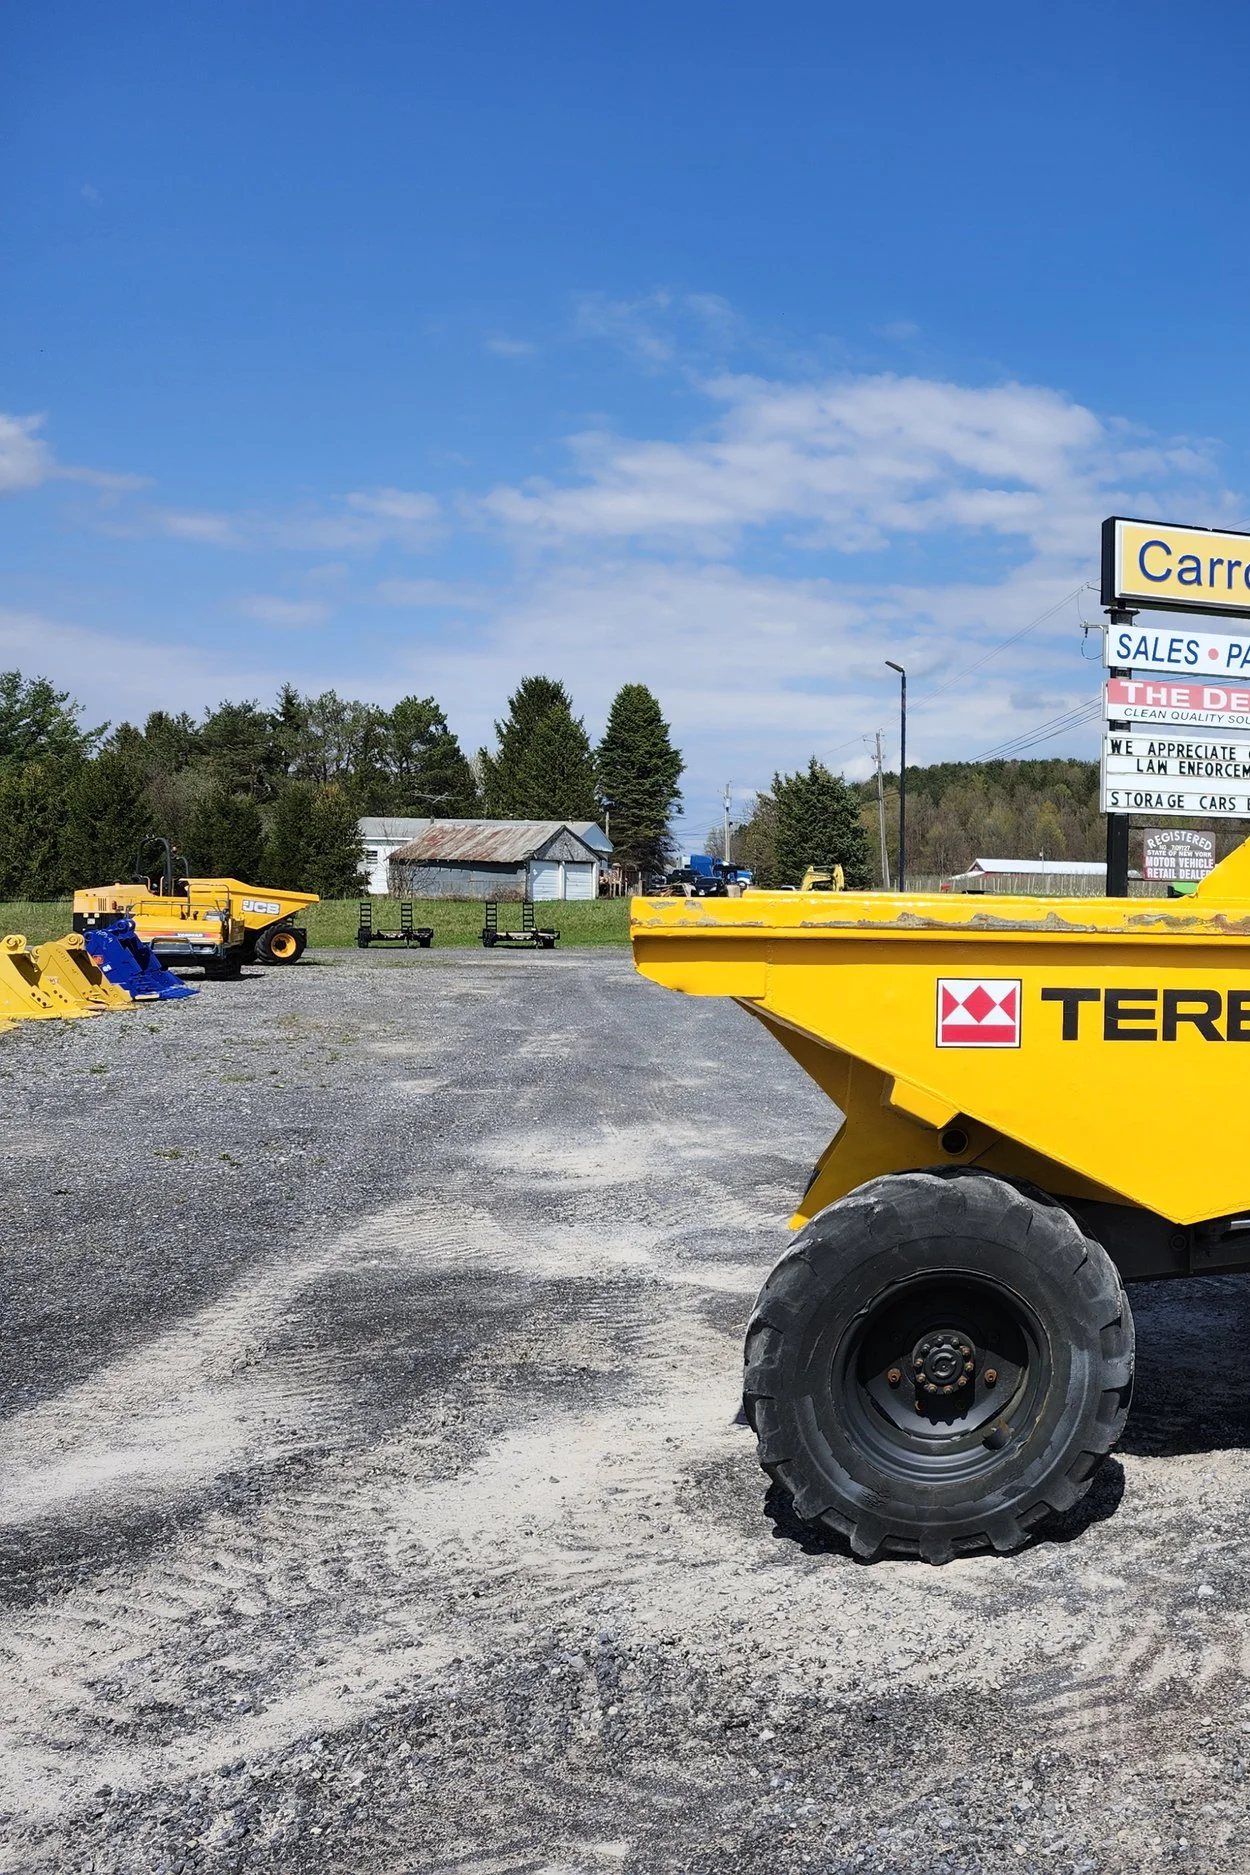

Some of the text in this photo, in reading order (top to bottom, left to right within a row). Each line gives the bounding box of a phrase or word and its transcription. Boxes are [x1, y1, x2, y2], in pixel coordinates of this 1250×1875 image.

[1116, 633, 1200, 665] SALES
[1120, 682, 1191, 708] THE
[1123, 707, 1167, 719] CLEAN
[1171, 711, 1225, 725] QUALITY
[1111, 740, 1133, 755] WE
[1148, 741, 1237, 761] APPRECIATE
[1136, 758, 1168, 775] LAW
[1111, 791, 1185, 808] STORAGE
[1199, 795, 1236, 811] CARS
[1147, 830, 1212, 851] REGISTERED
[1145, 856, 1214, 869] MOTOR VEHICLE
[1147, 867, 1177, 879] RETAIL
[242, 900, 280, 915] JCB
